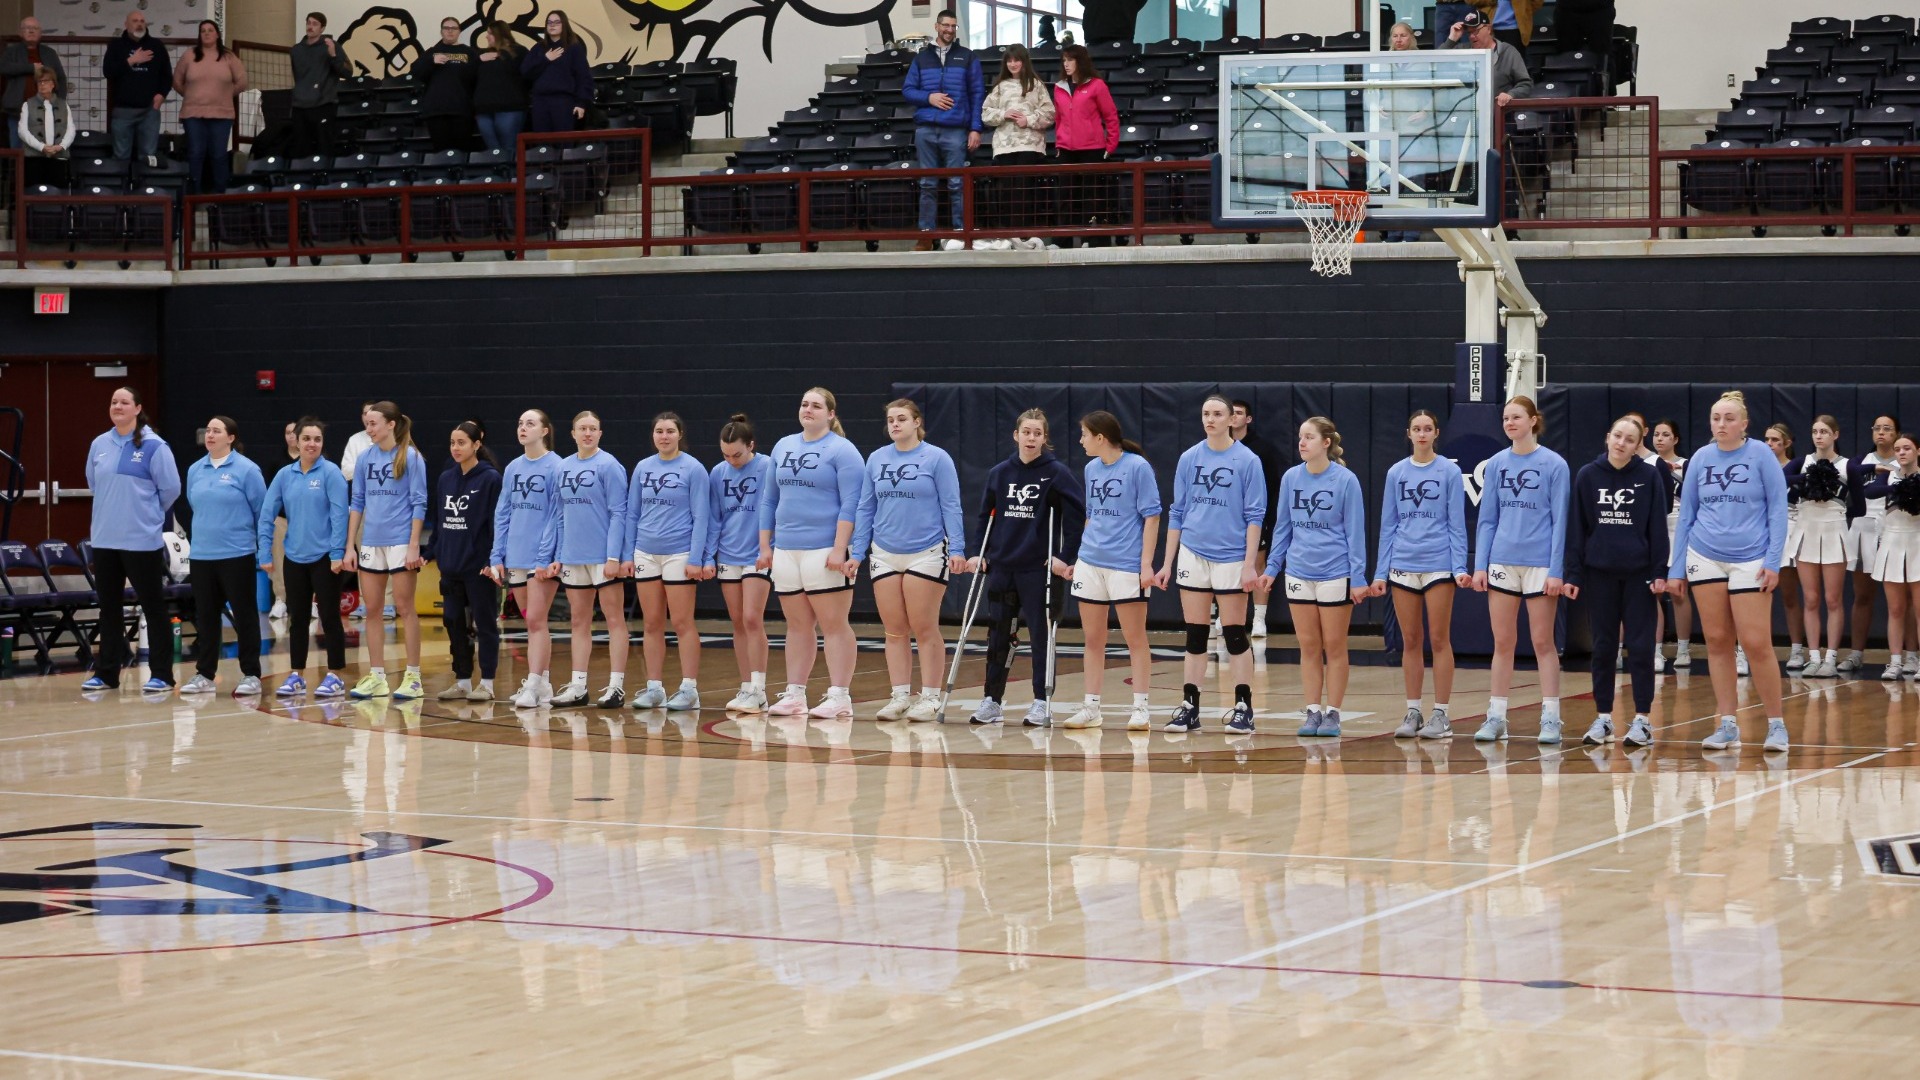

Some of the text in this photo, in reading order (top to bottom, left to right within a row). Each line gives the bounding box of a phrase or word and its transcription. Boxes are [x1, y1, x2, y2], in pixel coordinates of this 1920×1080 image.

[40, 293, 65, 313] EXIT
[1471, 347, 1480, 393] PORTER
[779, 451, 820, 477] LVC
[877, 463, 920, 489] LVC
[511, 473, 546, 500] LVC
[560, 469, 595, 495] LVC
[643, 471, 680, 496] LVC
[722, 476, 757, 504] LVC
[778, 479, 816, 488] BASKETBALL
[1192, 465, 1234, 494] LVC
[1499, 468, 1541, 498] LVC
[1703, 463, 1750, 492] LVC
[1006, 483, 1040, 505] LVC
[1090, 478, 1123, 506] LVC
[1291, 488, 1334, 519] LVC
[1398, 479, 1440, 509] LVC
[1597, 488, 1635, 511] LVC
[444, 495, 470, 517] LVC
[1288, 582, 1302, 593] LVC
